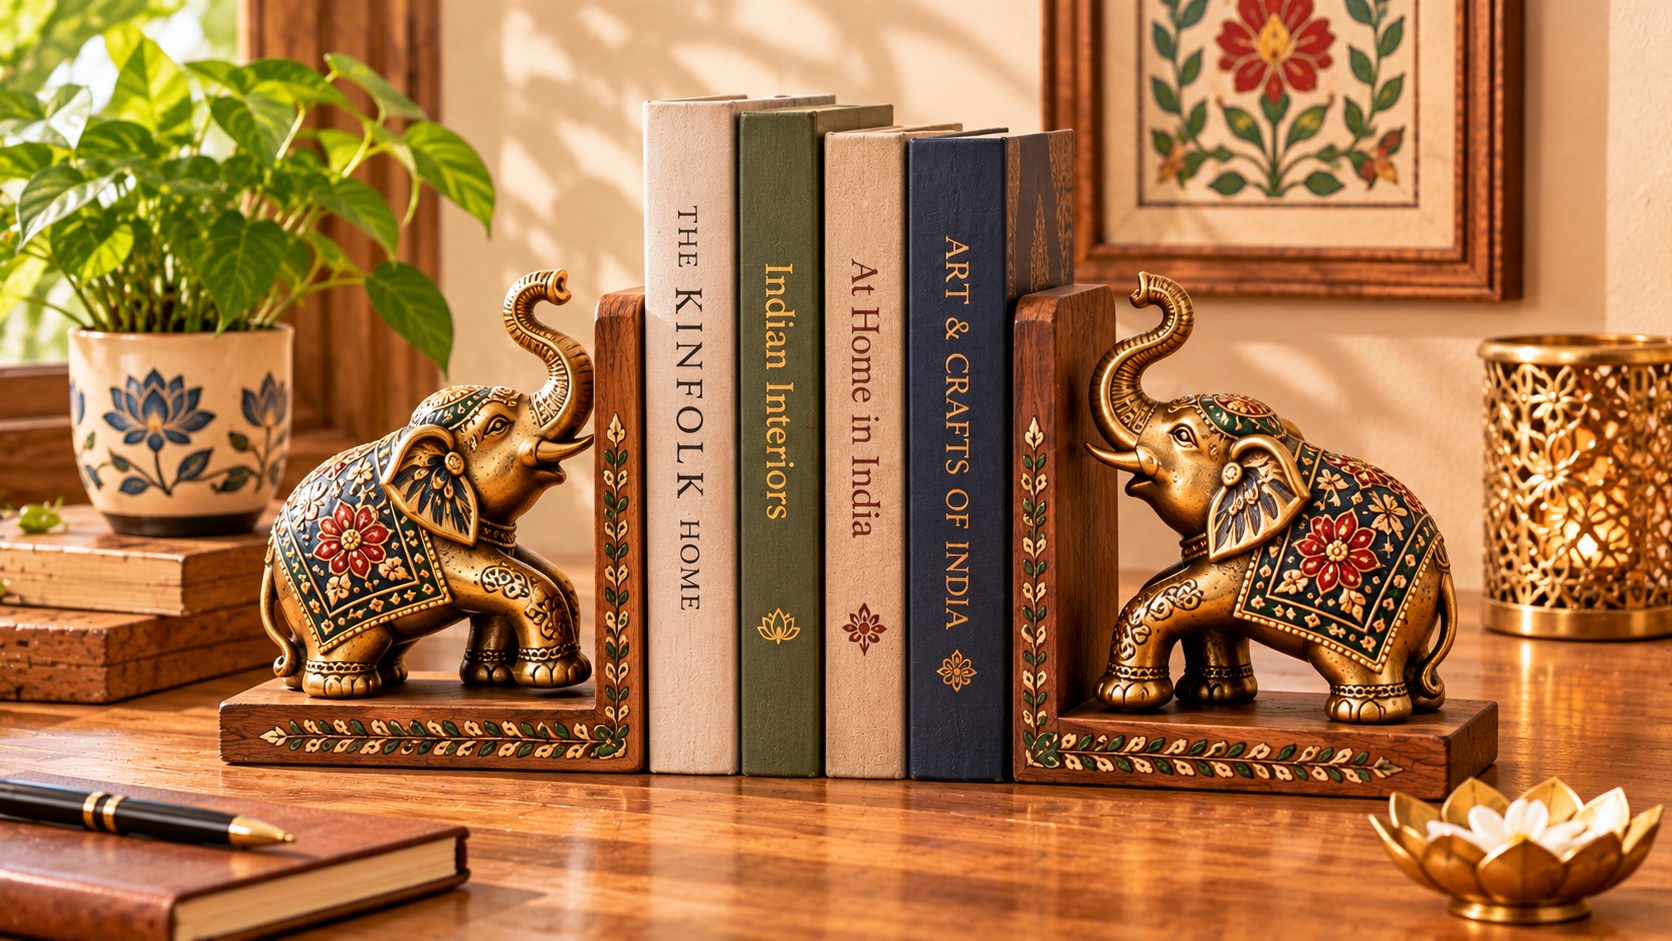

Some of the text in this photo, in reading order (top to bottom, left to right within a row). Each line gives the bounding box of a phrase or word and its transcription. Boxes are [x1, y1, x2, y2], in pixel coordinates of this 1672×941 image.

[675, 205, 704, 611] THE KINFOLK HOME
[765, 263, 796, 520] Indian Interiors
[851, 258, 881, 538] At Home in India
[945, 236, 970, 630] ART & CRAFTS OF INDIA
